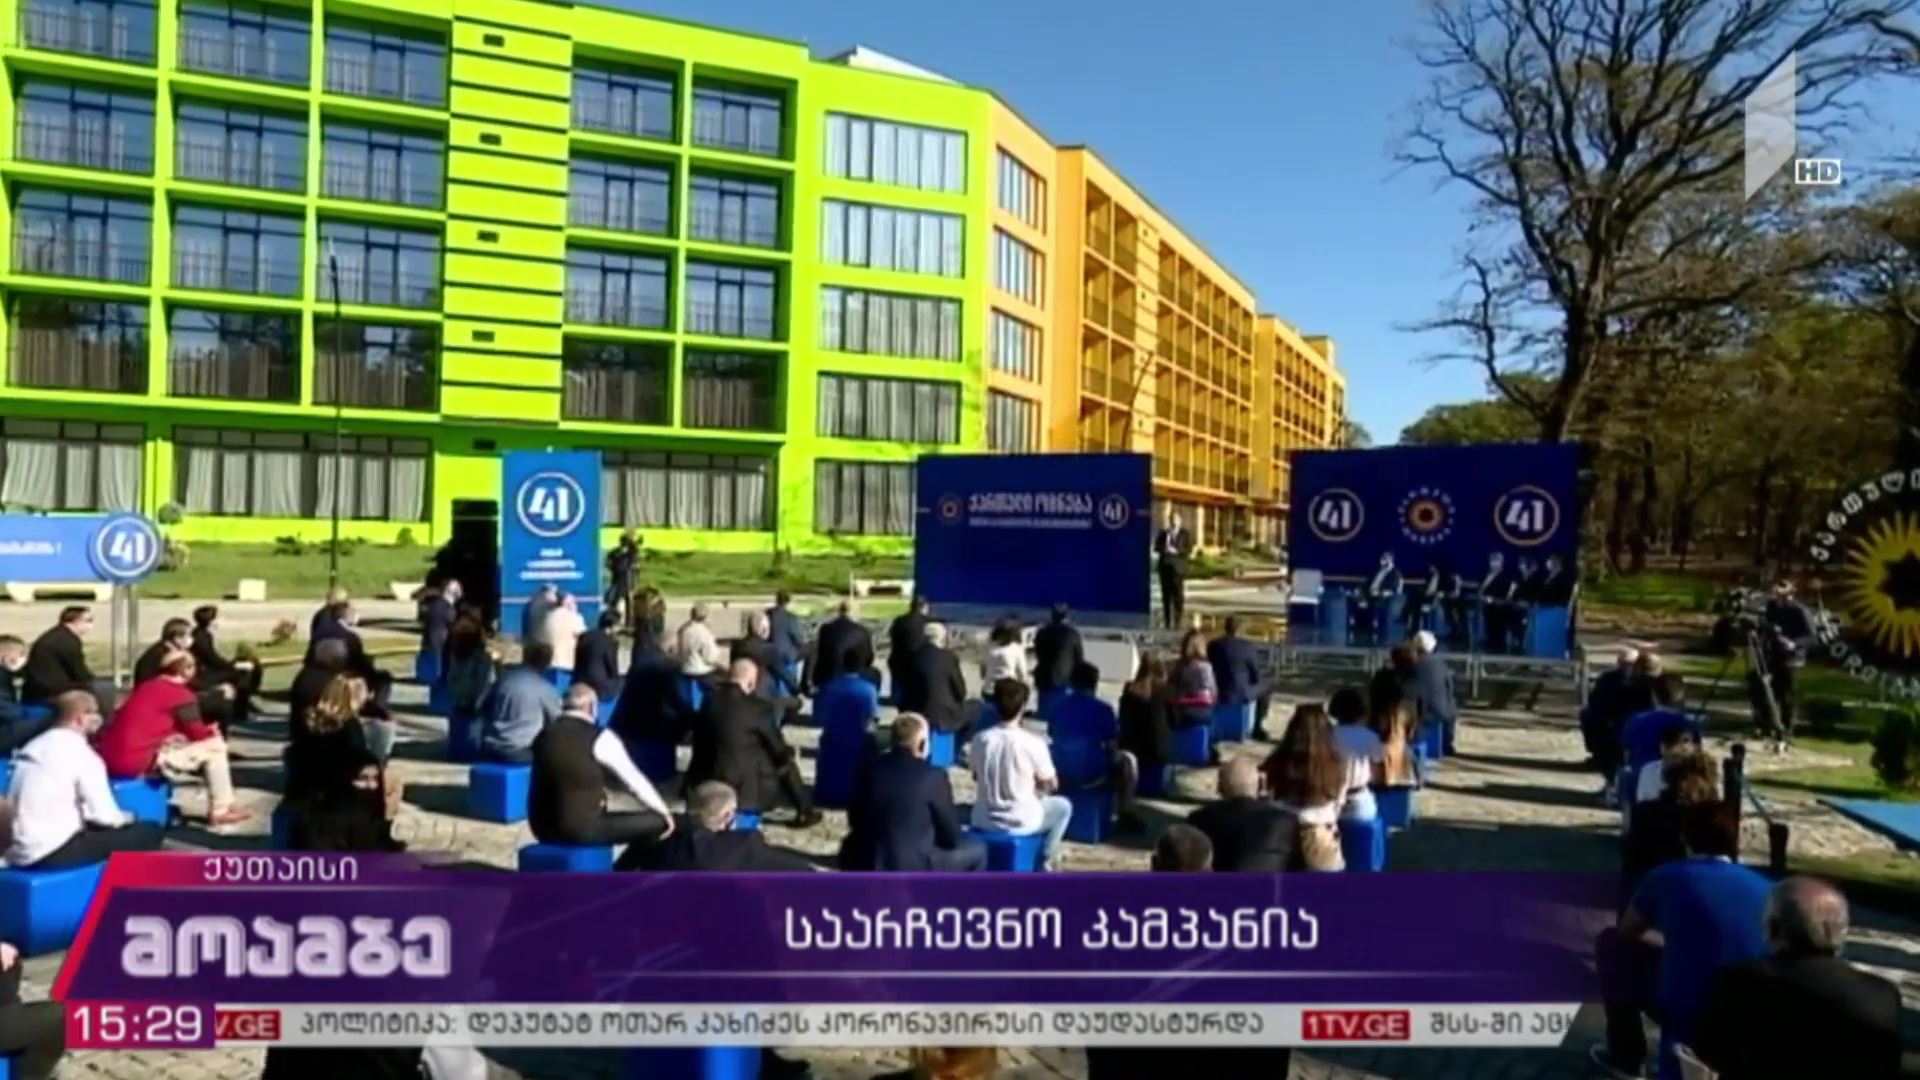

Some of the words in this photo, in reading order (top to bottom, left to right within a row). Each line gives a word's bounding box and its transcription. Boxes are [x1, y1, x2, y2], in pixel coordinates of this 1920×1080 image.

[529, 486, 570, 522] 41
[1104, 502, 1122, 522] 41
[1317, 499, 1351, 530] 41
[1504, 499, 1545, 532] 41
[109, 530, 147, 564] 41
